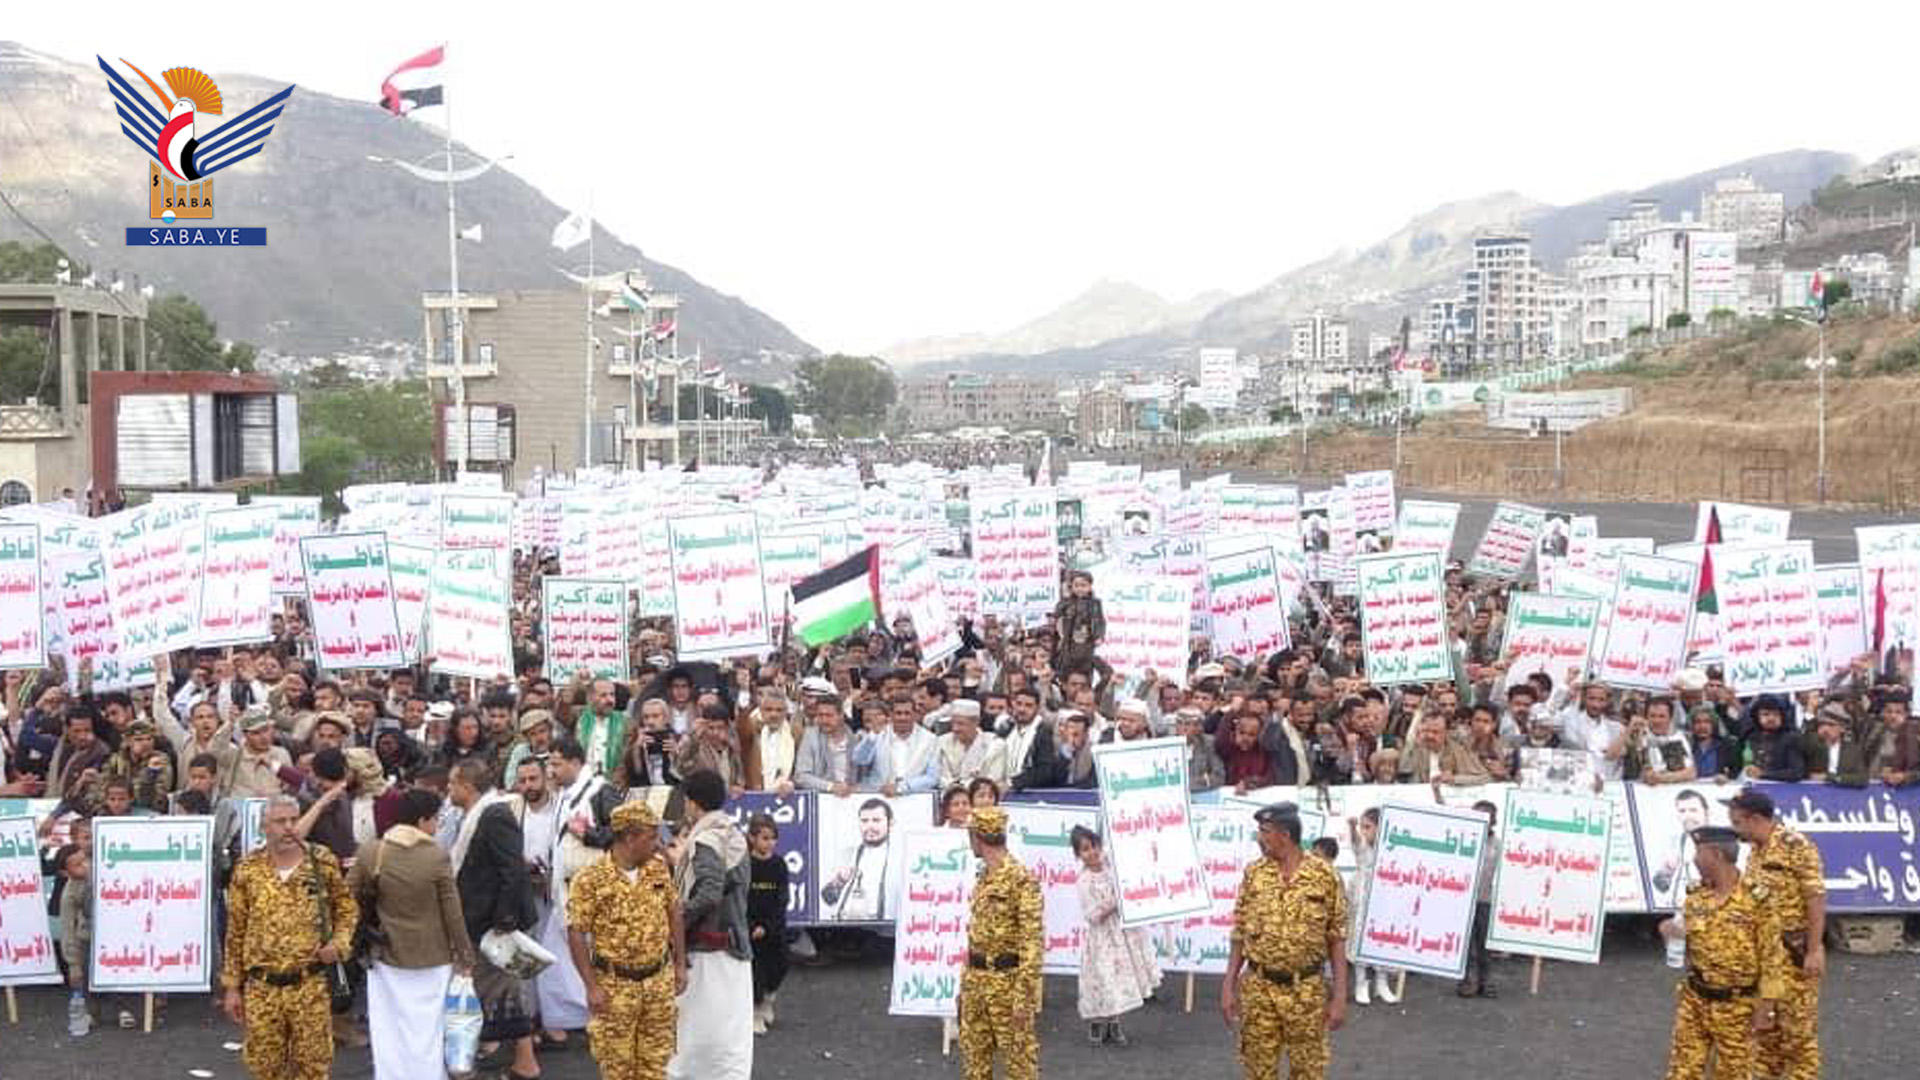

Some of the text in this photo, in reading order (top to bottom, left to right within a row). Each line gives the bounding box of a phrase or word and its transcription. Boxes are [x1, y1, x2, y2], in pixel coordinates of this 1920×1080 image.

[979, 499, 1050, 526] الله أكبر
[306, 544, 385, 577] قاطعوا
[1409, 563, 1438, 581] الله
[1776, 551, 1807, 576] الله
[1365, 561, 1406, 591] أكبر
[594, 588, 622, 606] الله
[1103, 757, 1181, 801] قاطعوا
[1510, 799, 1605, 837] قاطعوا
[101, 831, 202, 869] قاطعوا
[1383, 817, 1478, 859] قاطعوا
[910, 841, 969, 878] أكبر
[1554, 849, 1601, 877] البضائع
[155, 877, 202, 906] البضائع
[1425, 869, 1472, 897] البضائع
[1541, 877, 1550, 899] و
[1824, 853, 1894, 902] واح
[1411, 895, 1421, 917] و
[144, 911, 152, 933] و
